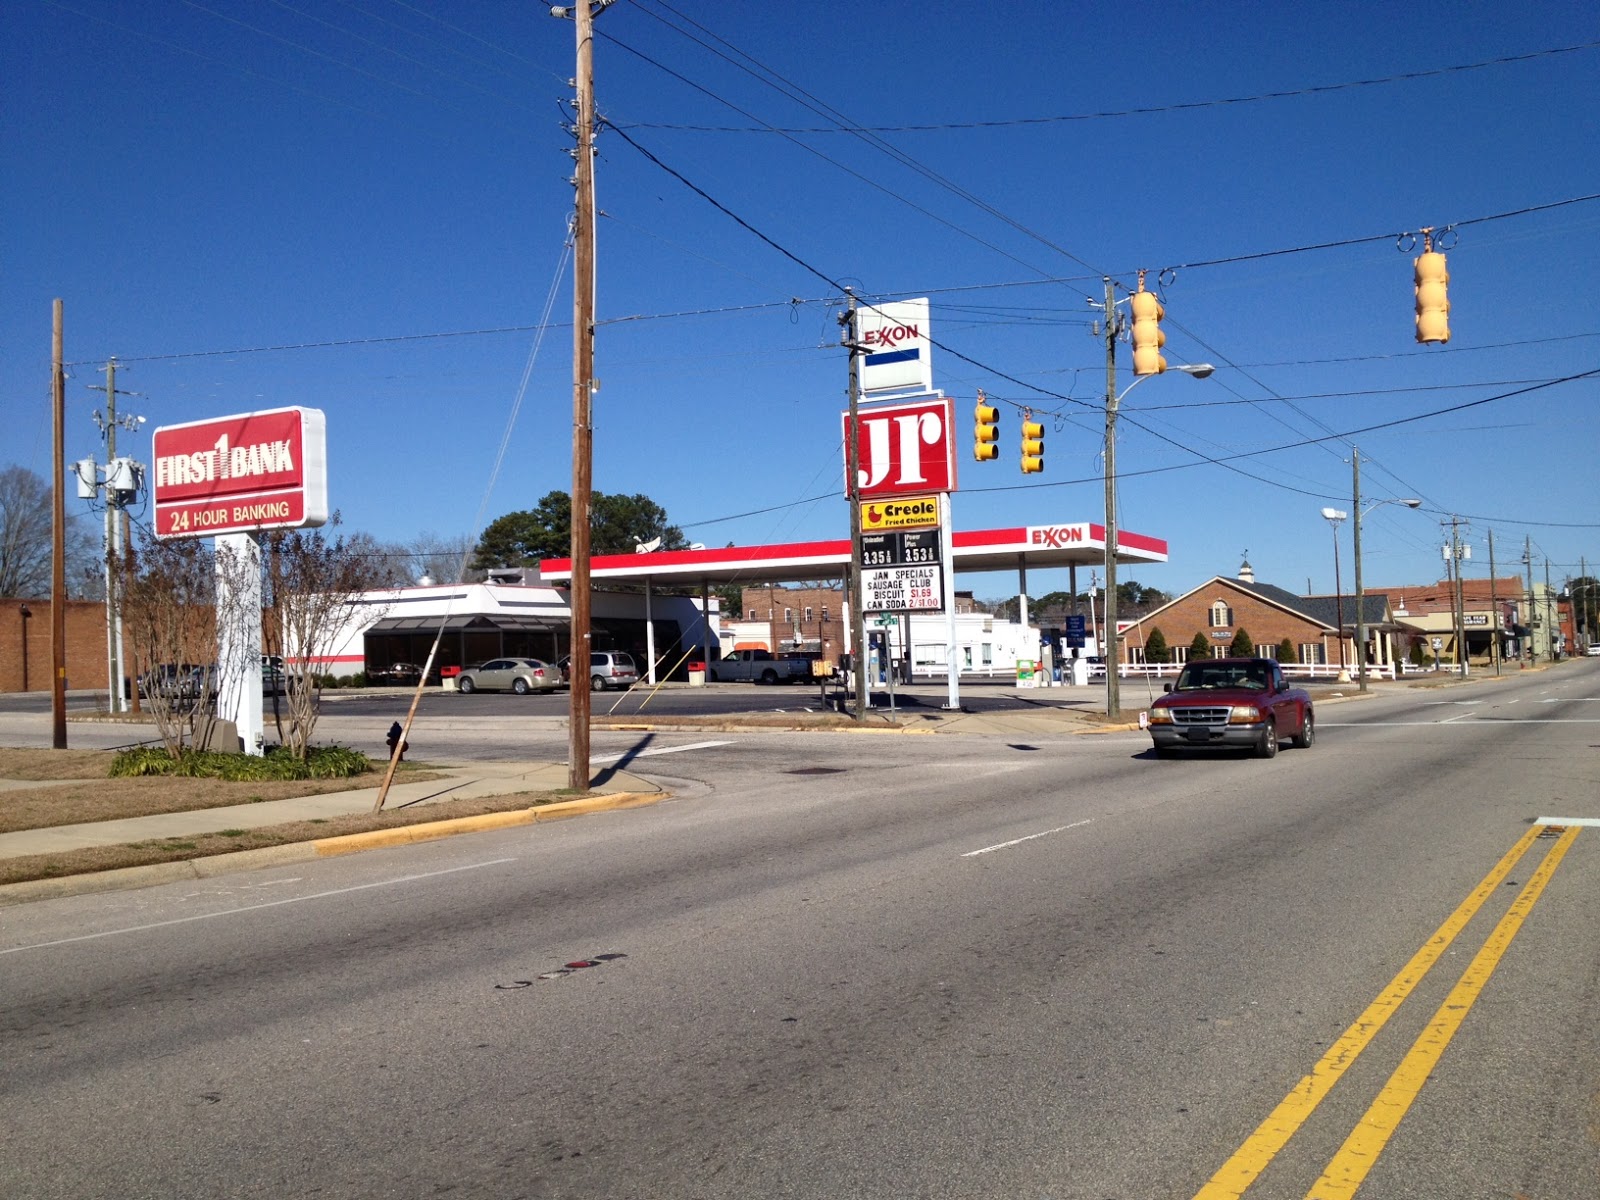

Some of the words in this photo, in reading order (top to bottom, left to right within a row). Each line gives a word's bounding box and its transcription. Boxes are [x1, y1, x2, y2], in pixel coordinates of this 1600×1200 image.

[864, 323, 919, 347] EXXON
[156, 450, 216, 487] FIRST
[230, 439, 294, 478] BANK
[170, 510, 190, 532] 24
[193, 508, 228, 527] HOUR
[233, 501, 289, 522] BANKING
[884, 502, 935, 517] Creole
[905, 517, 935, 525] Chicken
[1031, 526, 1082, 548] EXXON
[873, 571, 889, 580] JAN
[895, 569, 934, 580] SPECIALS
[867, 580, 903, 590] SAUSAGE
[910, 579, 931, 588] CLUB
[874, 590, 905, 600] BISCUIT
[867, 601, 883, 610] CAN
[885, 599, 907, 609] SODA
[908, 597, 938, 608] 2/$1.00
